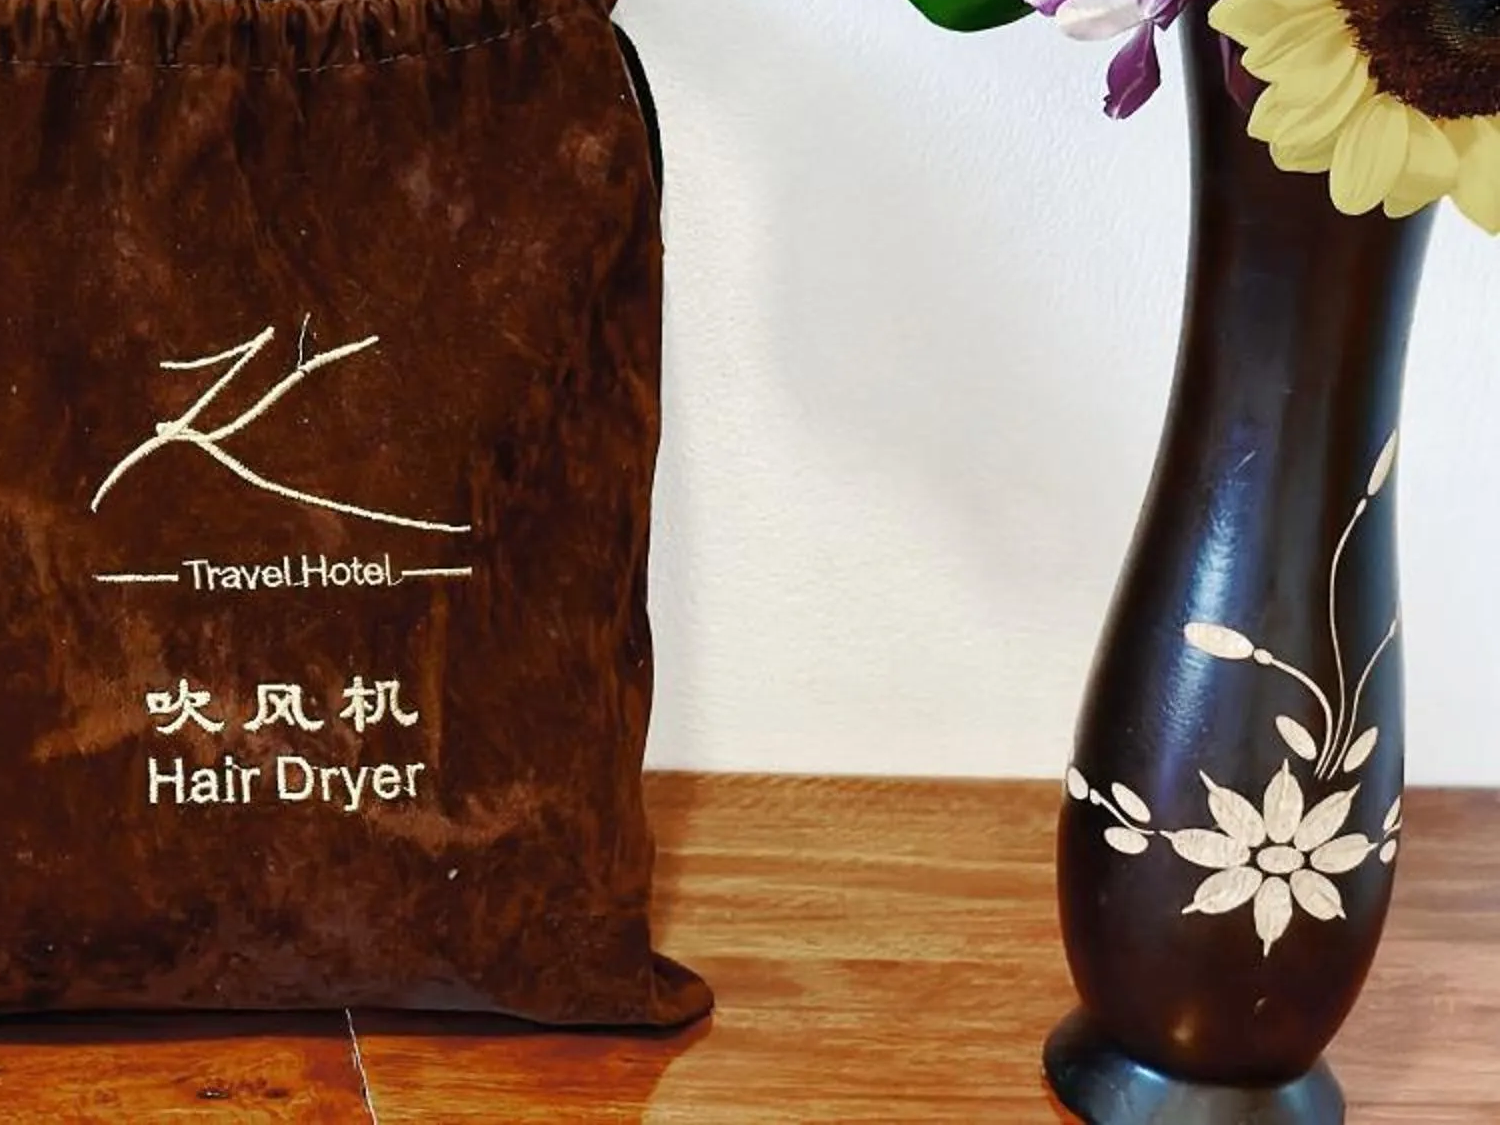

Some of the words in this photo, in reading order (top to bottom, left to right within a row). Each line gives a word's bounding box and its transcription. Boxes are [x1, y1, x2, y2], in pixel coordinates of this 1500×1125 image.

[182, 554, 291, 590] Travel
[299, 554, 392, 588] Hotel
[146, 676, 419, 735] 吹风机
[148, 754, 261, 804] Hair
[277, 756, 425, 812] Dryer
